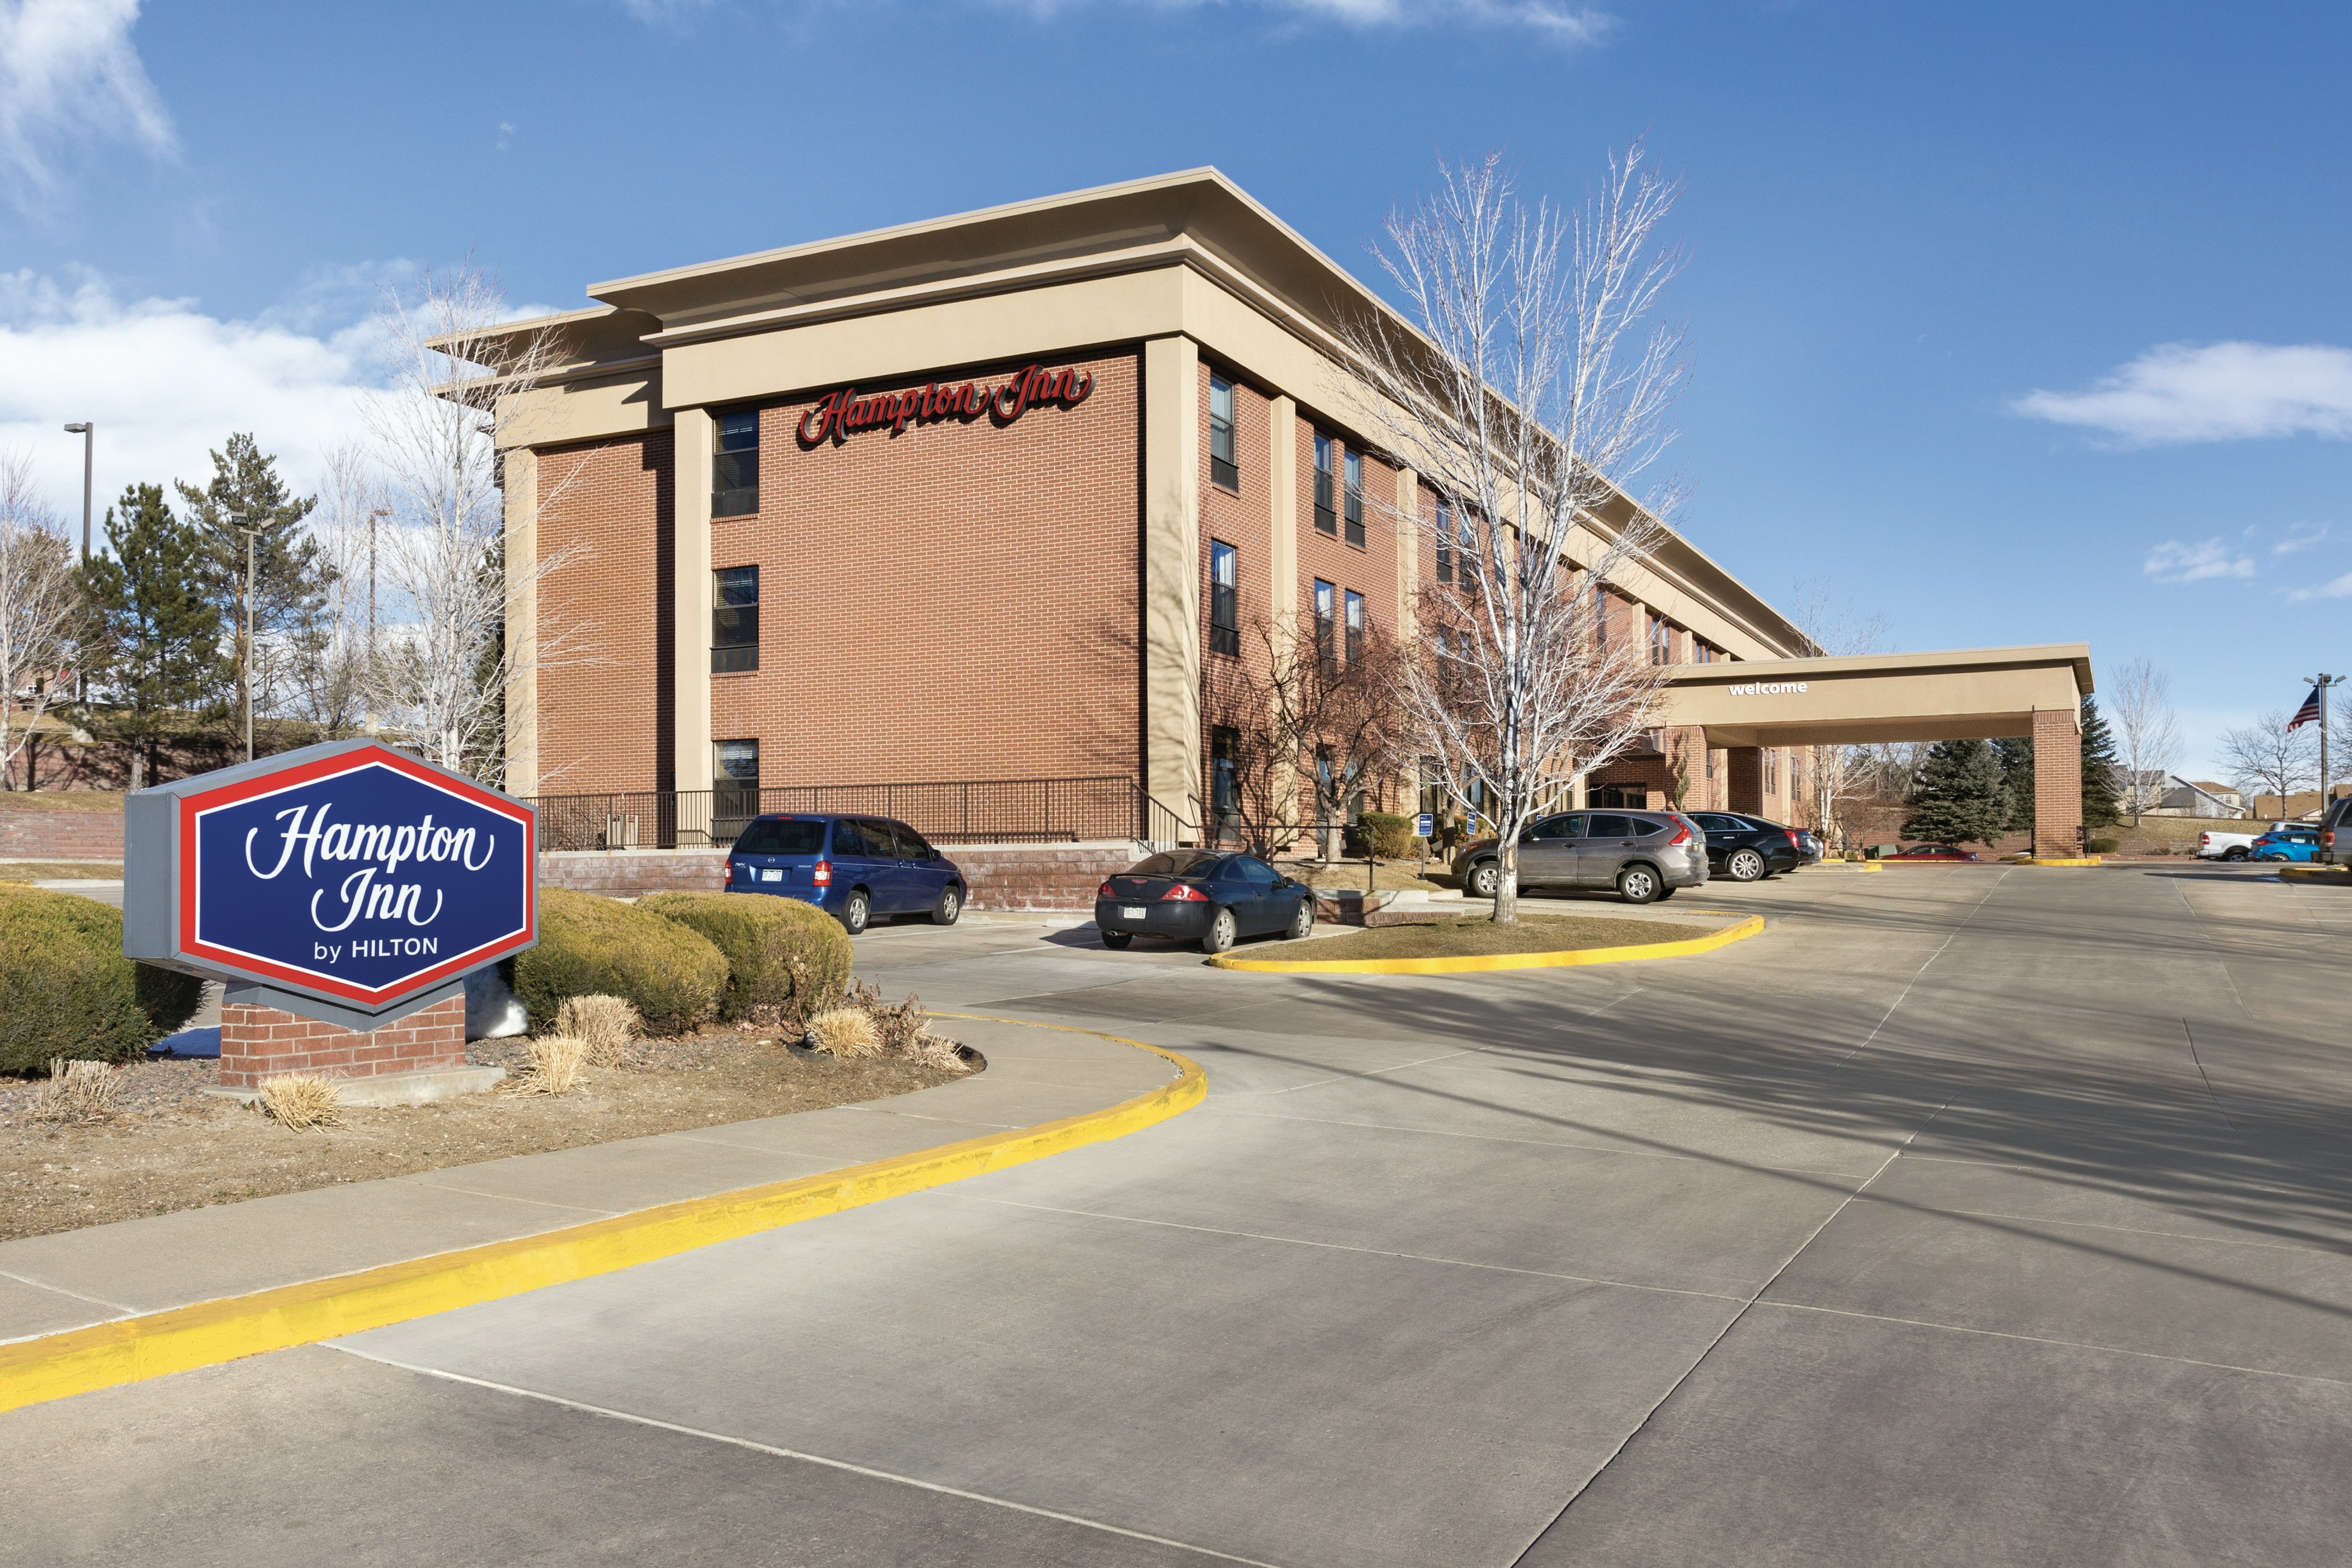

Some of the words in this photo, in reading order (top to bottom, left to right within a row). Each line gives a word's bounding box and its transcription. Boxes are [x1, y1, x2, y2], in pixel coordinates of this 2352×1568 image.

[800, 383, 992, 442] Hampton
[995, 364, 1094, 419] Inn
[1728, 682, 1807, 696] welcome
[245, 803, 494, 880] Hampton
[311, 867, 443, 932] Inn
[314, 941, 342, 964] by
[352, 937, 438, 958] HILTON
